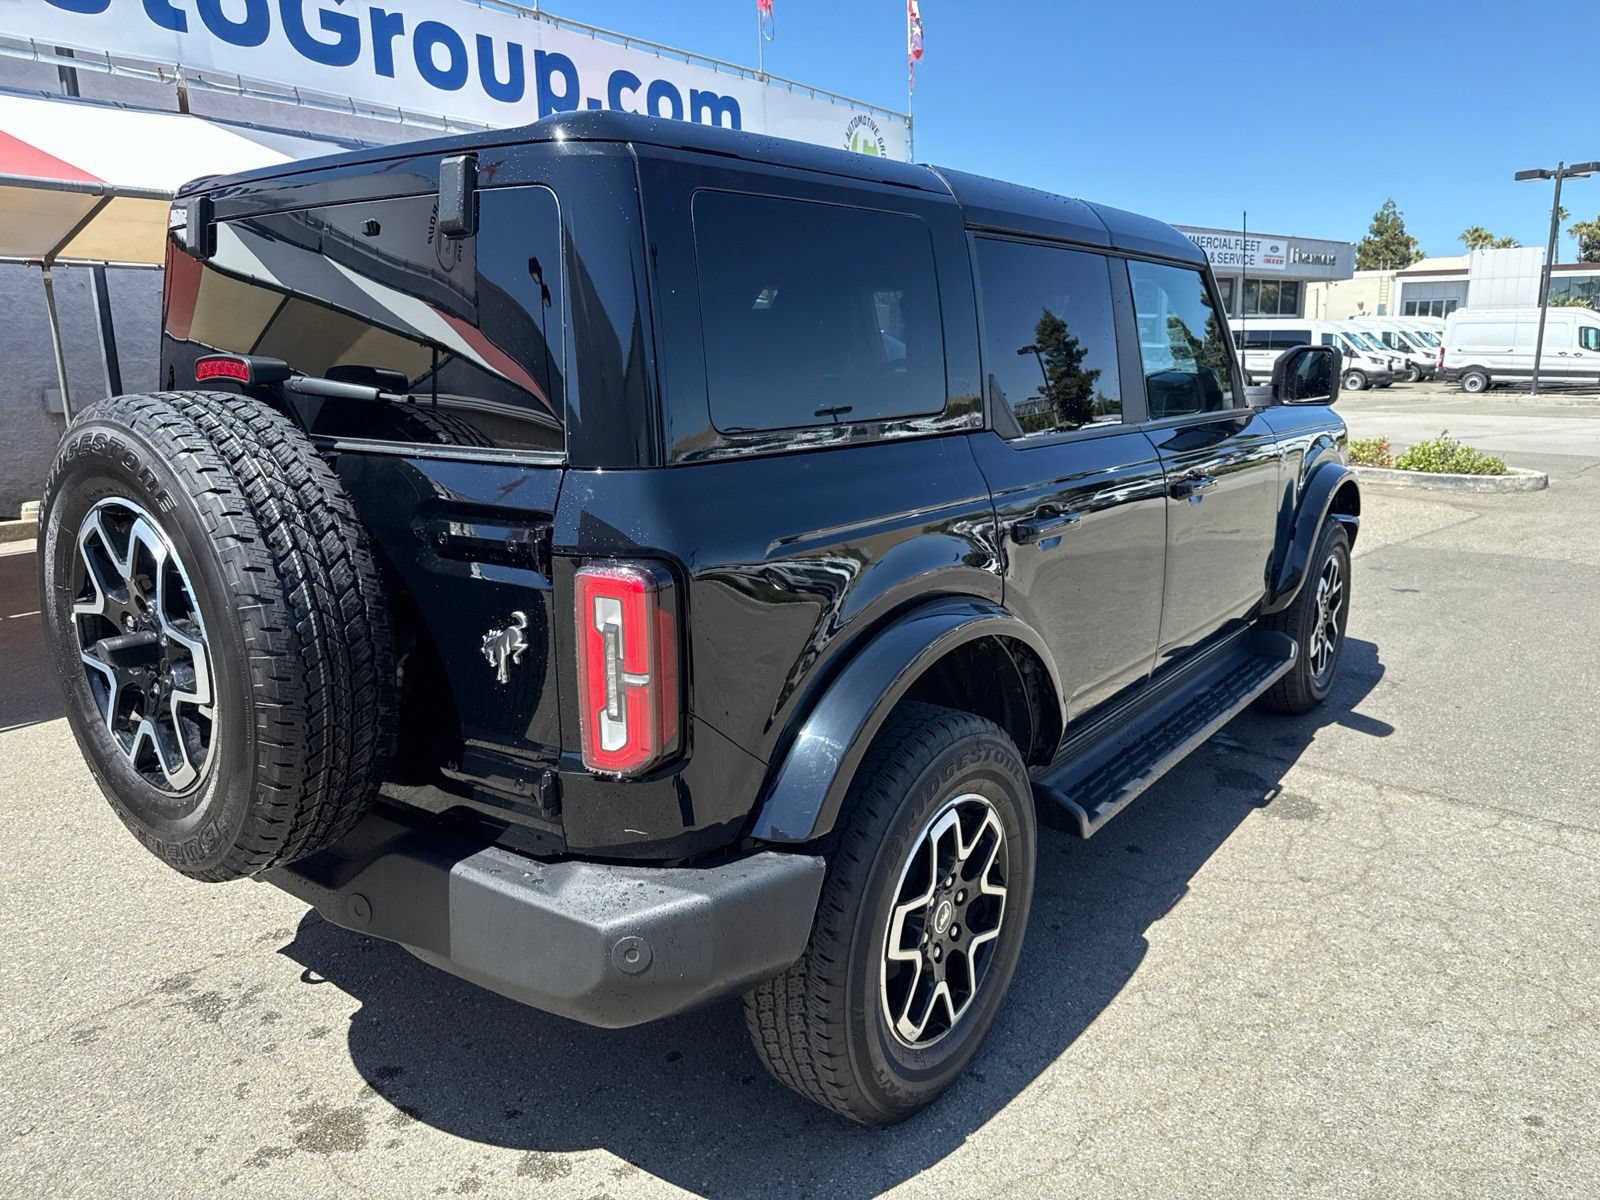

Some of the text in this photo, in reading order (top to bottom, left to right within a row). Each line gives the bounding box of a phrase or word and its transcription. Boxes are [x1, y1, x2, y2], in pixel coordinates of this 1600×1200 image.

[44, 0, 742, 131] oGroup.com
[845, 114, 880, 142] AUTOMOTIVE
[1234, 239, 1262, 252] FLEET
[1210, 252, 1216, 264] &
[1217, 252, 1255, 266] SERVICE
